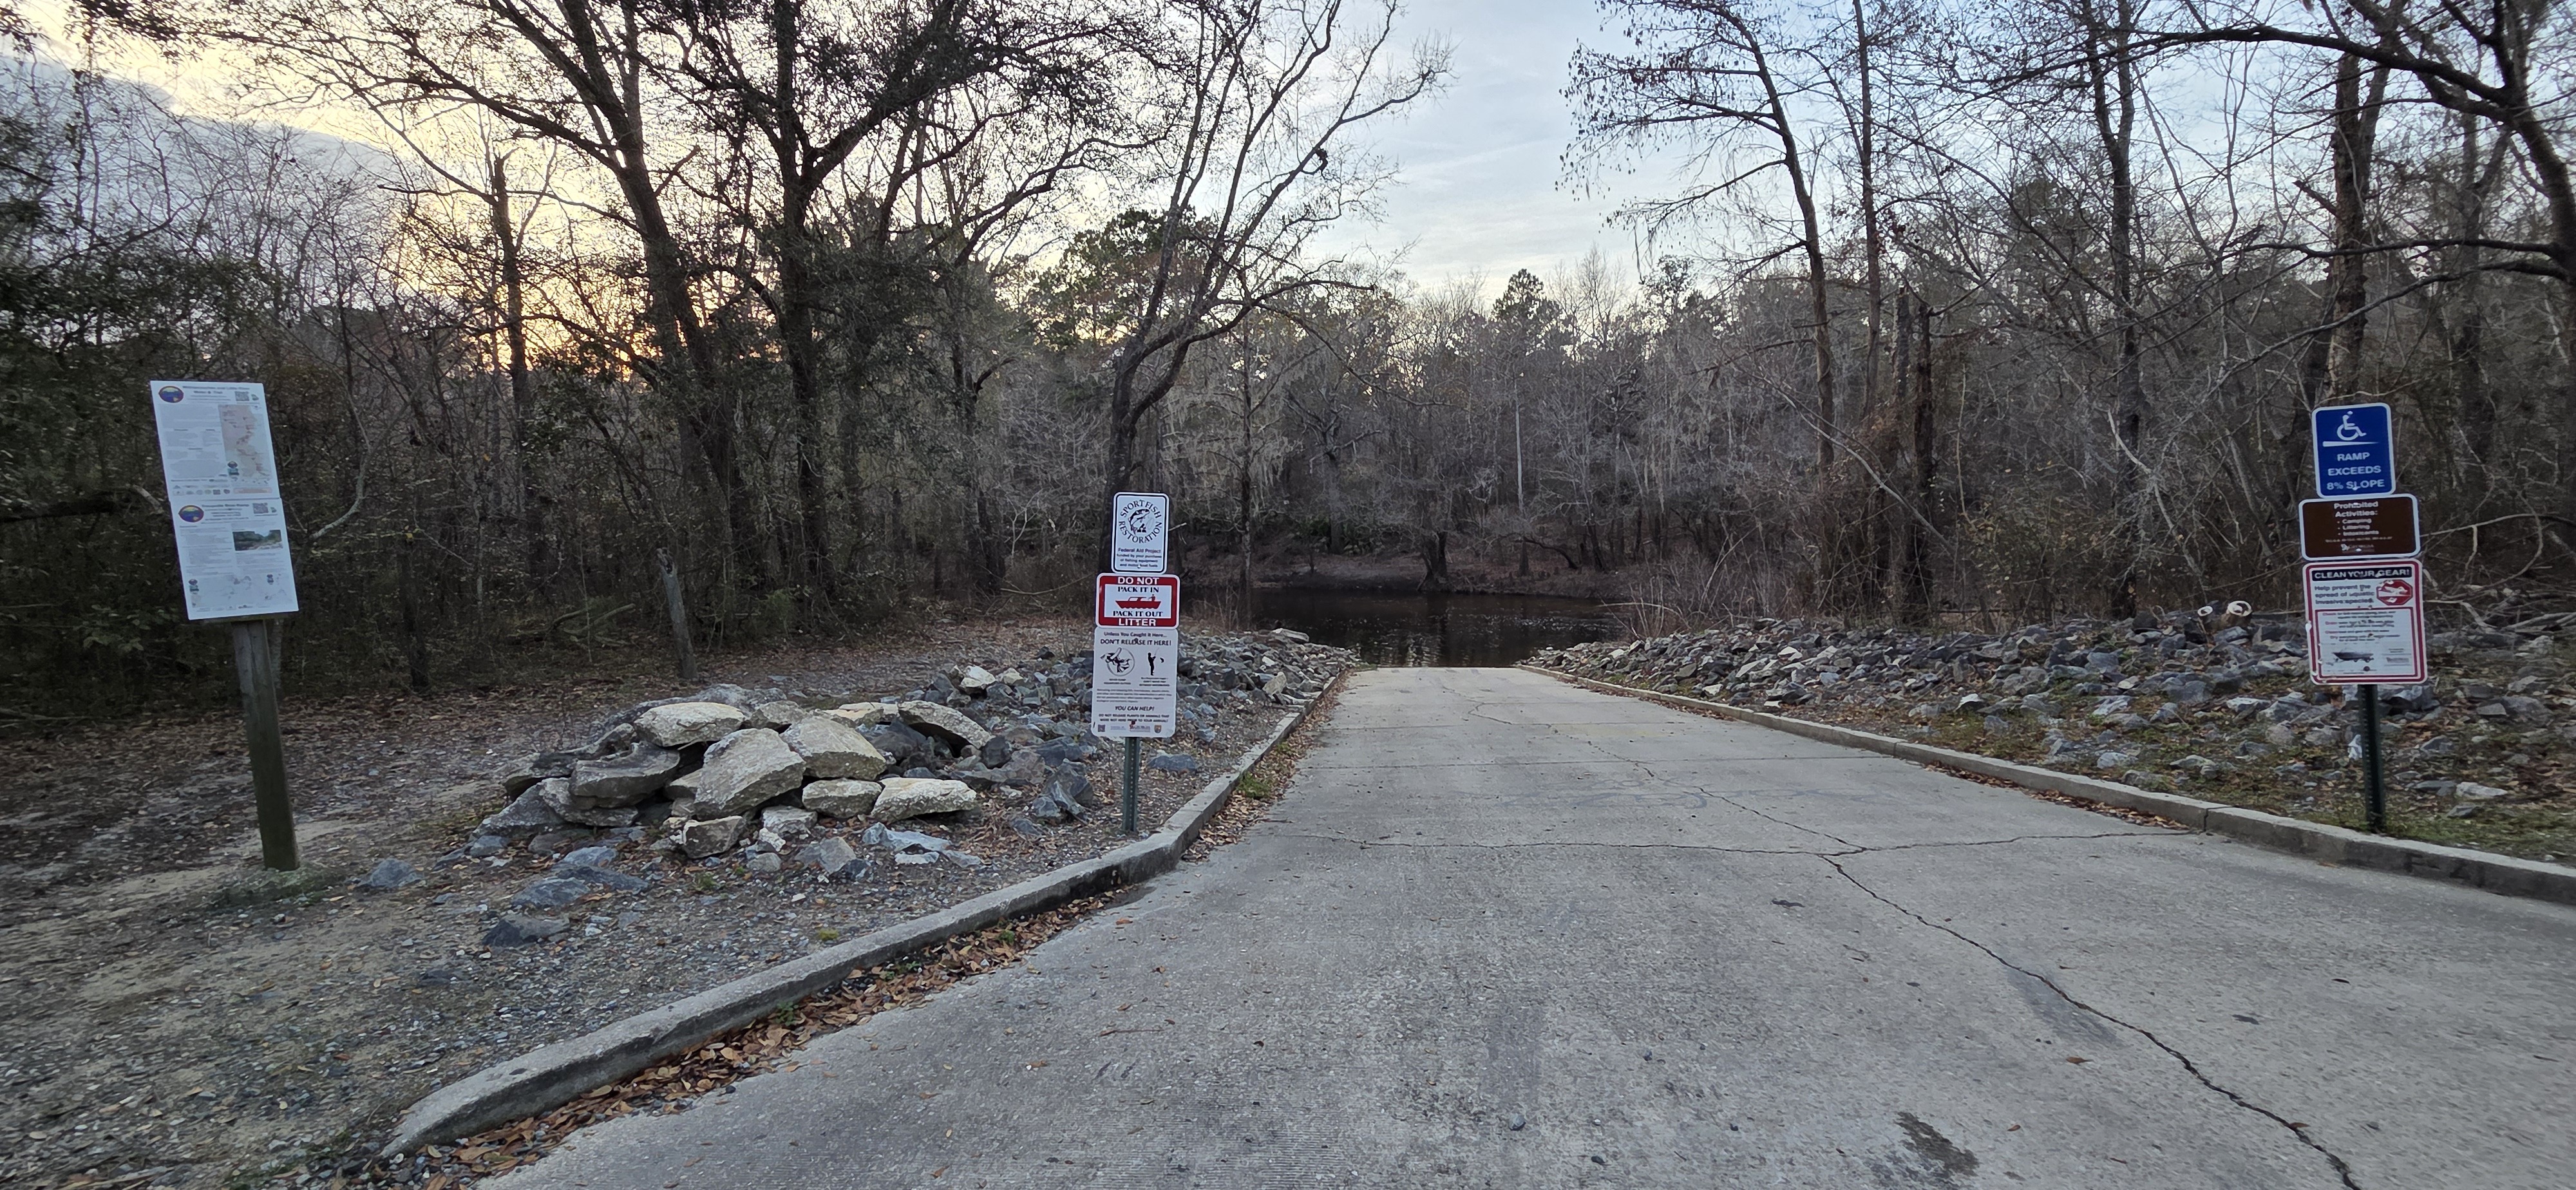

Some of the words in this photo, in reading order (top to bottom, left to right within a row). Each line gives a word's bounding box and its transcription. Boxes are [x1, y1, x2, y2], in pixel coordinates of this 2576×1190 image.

[2336, 451, 2370, 461] RAMP
[2327, 465, 2382, 476] EXCEEDS
[2327, 481, 2344, 490] 8%
[2346, 478, 2385, 490] SLOPE
[2333, 501, 2379, 509] Prohibited
[1118, 520, 1162, 544] RESTORATION
[1117, 576, 1134, 585] DO
[1137, 577, 1160, 585] NOT
[1119, 618, 1157, 627] LITTER
